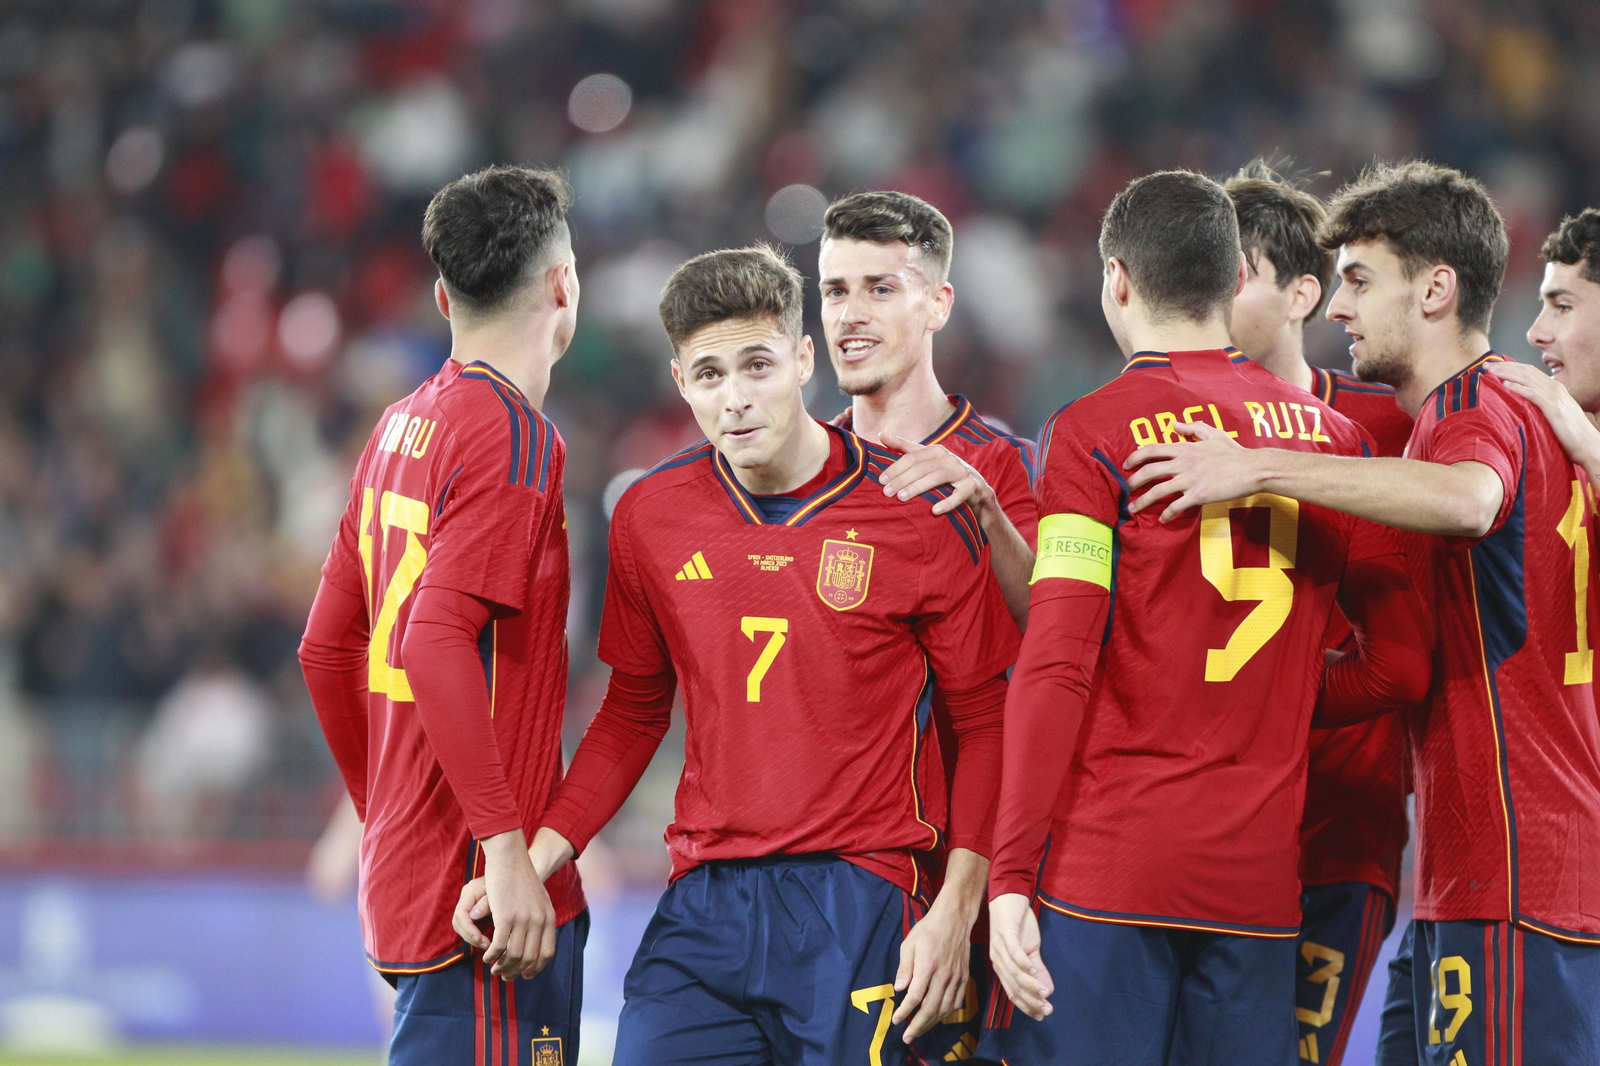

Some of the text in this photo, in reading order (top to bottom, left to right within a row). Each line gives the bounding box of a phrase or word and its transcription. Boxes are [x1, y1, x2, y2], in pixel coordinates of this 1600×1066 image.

[1244, 401, 1331, 443] RUIZ
[1056, 541, 1109, 561] RESPECT
[1200, 492, 1299, 682] 9
[1556, 480, 1600, 685] 1
[740, 616, 789, 702] 7
[850, 983, 895, 1066] 7
[1429, 955, 1473, 1045] 19
